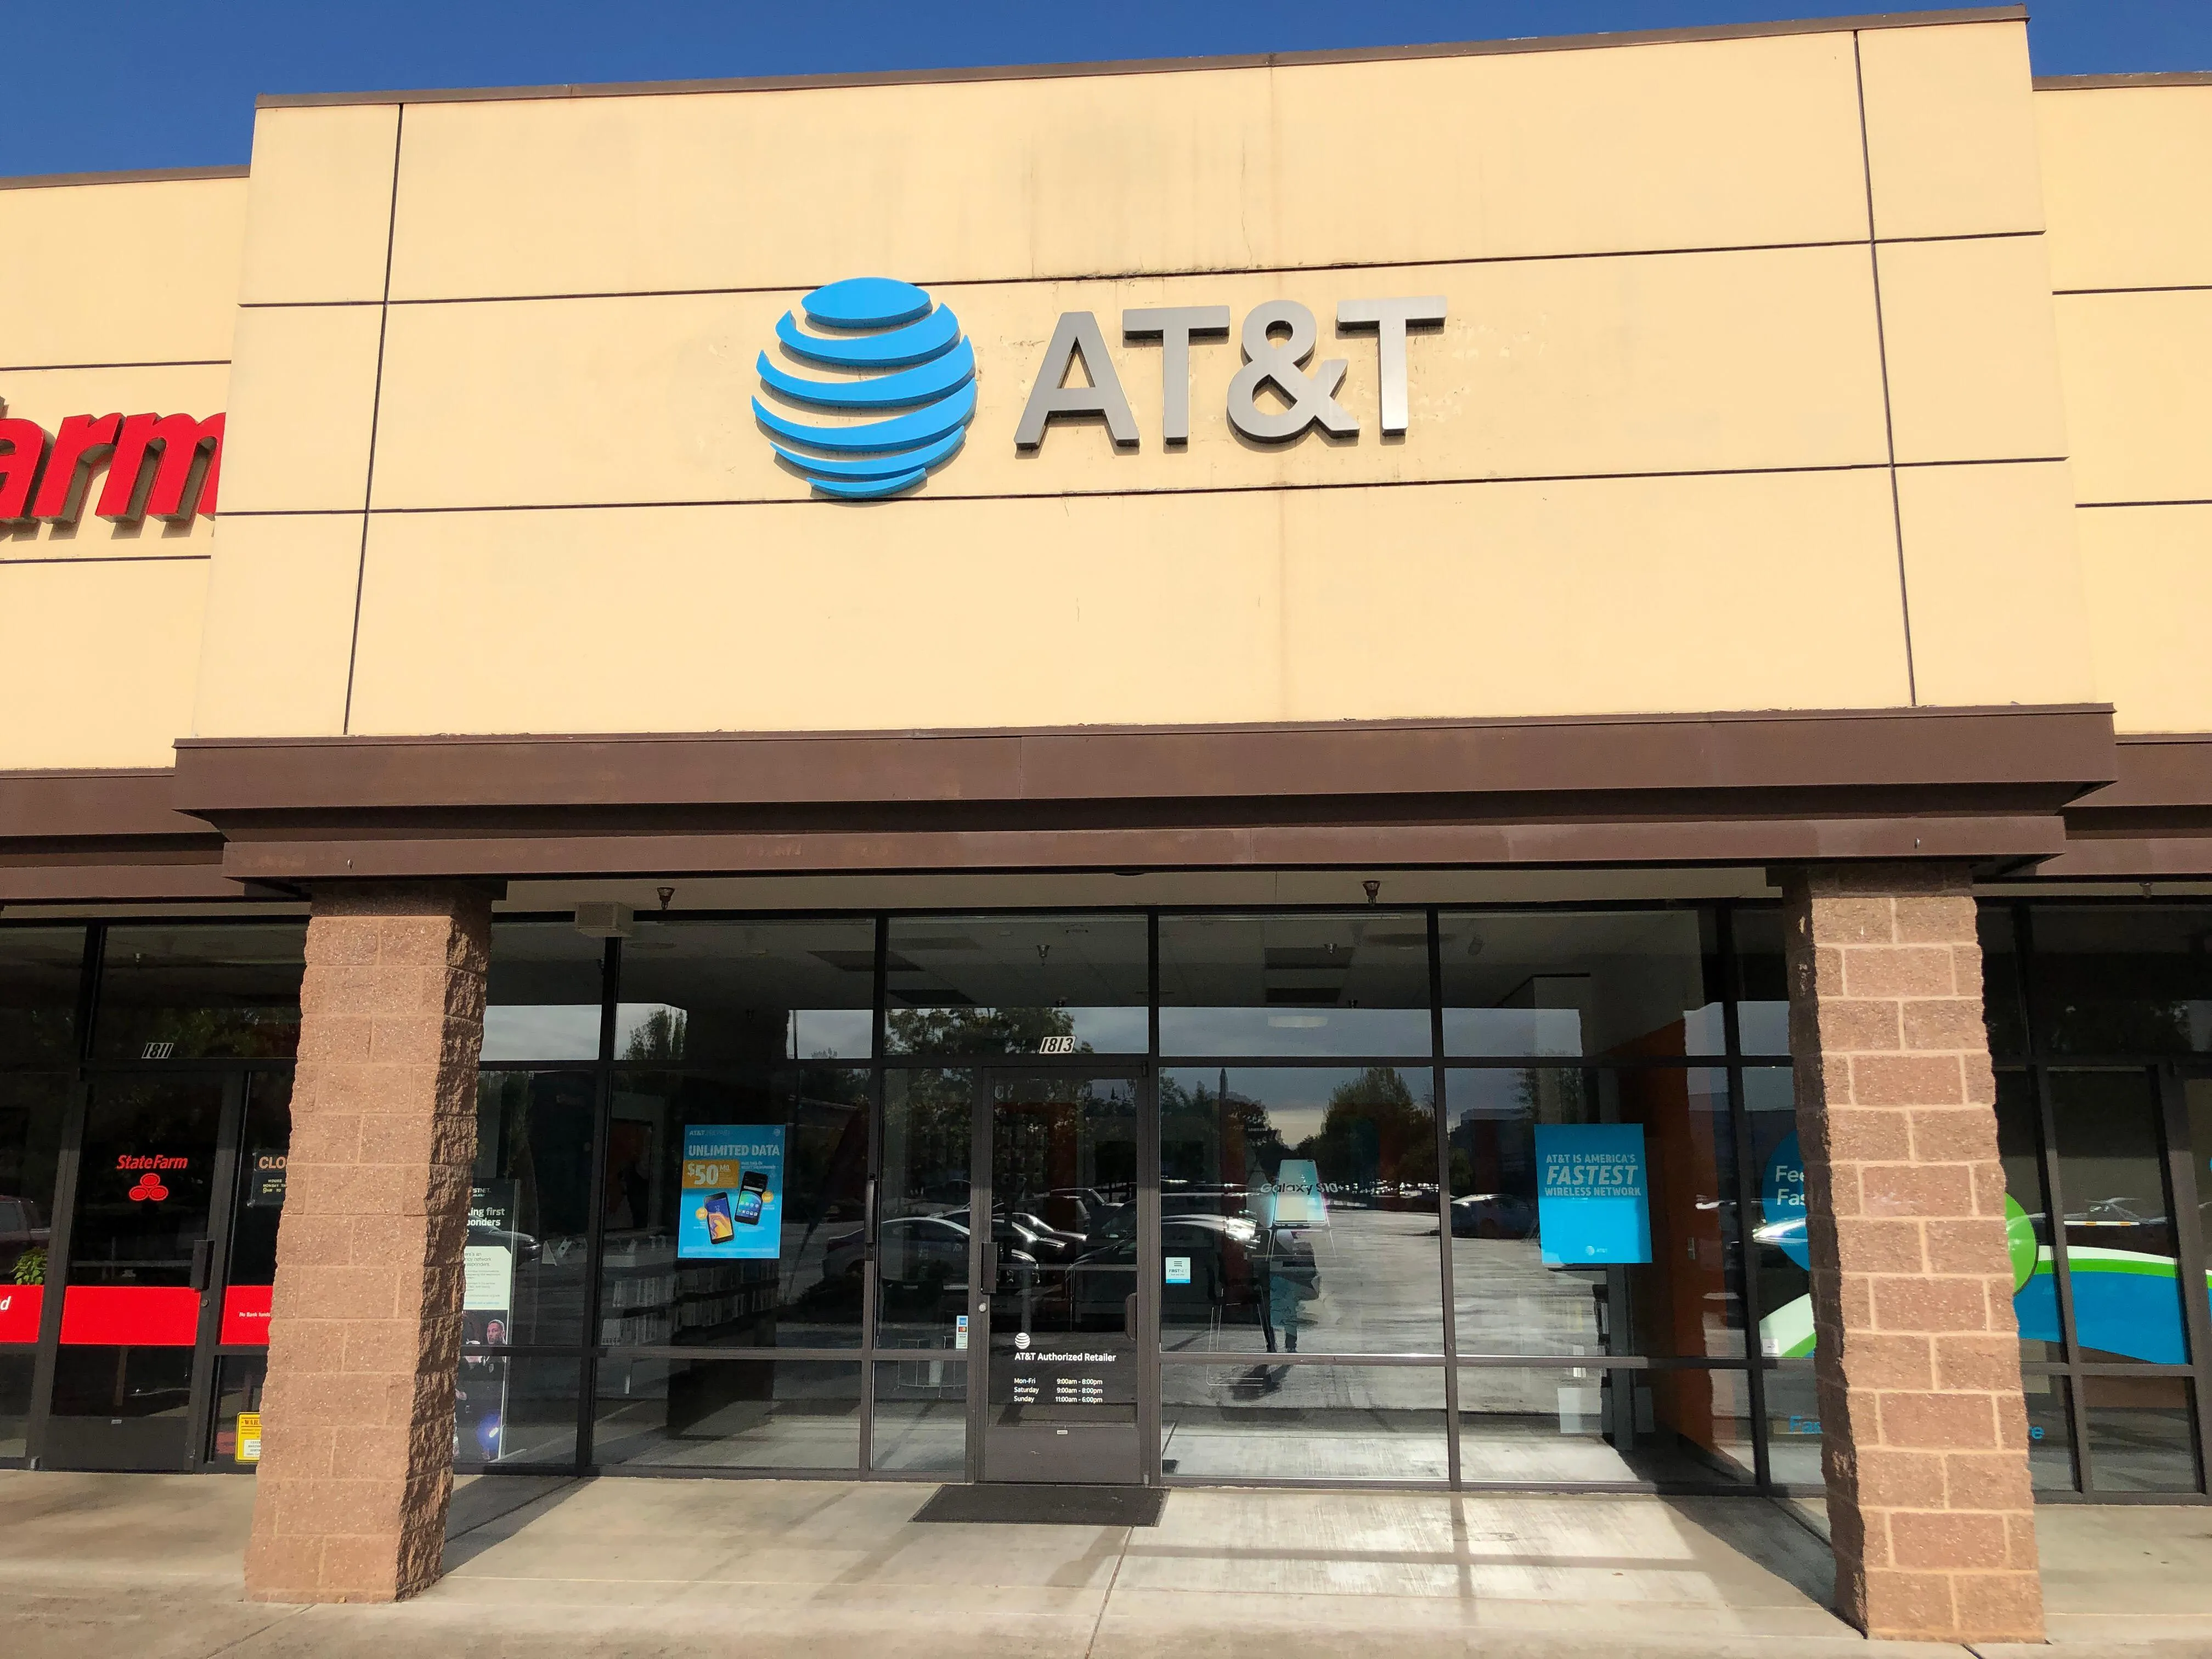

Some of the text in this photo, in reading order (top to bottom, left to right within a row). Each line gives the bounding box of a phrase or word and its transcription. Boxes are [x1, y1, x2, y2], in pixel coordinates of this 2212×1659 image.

[1014, 295, 1448, 451] AT&T
[0, 412, 226, 518] arm
[143, 1043, 172, 1058] 1811
[1041, 1037, 1074, 1052] 1813
[689, 1145, 780, 1156] UNLIMITED DATA
[1547, 1154, 1635, 1163] AT&T IS AMERICA'S
[687, 1163, 719, 1185] $50
[1547, 1165, 1638, 1185] FASTEST
[1260, 1183, 1313, 1195] Galaxy
[1545, 1187, 1641, 1196] WIRELESS NETWORK
[486, 1207, 505, 1216] first
[1037, 1353, 1082, 1361] Authorized
[1085, 1353, 1116, 1362] Retailer
